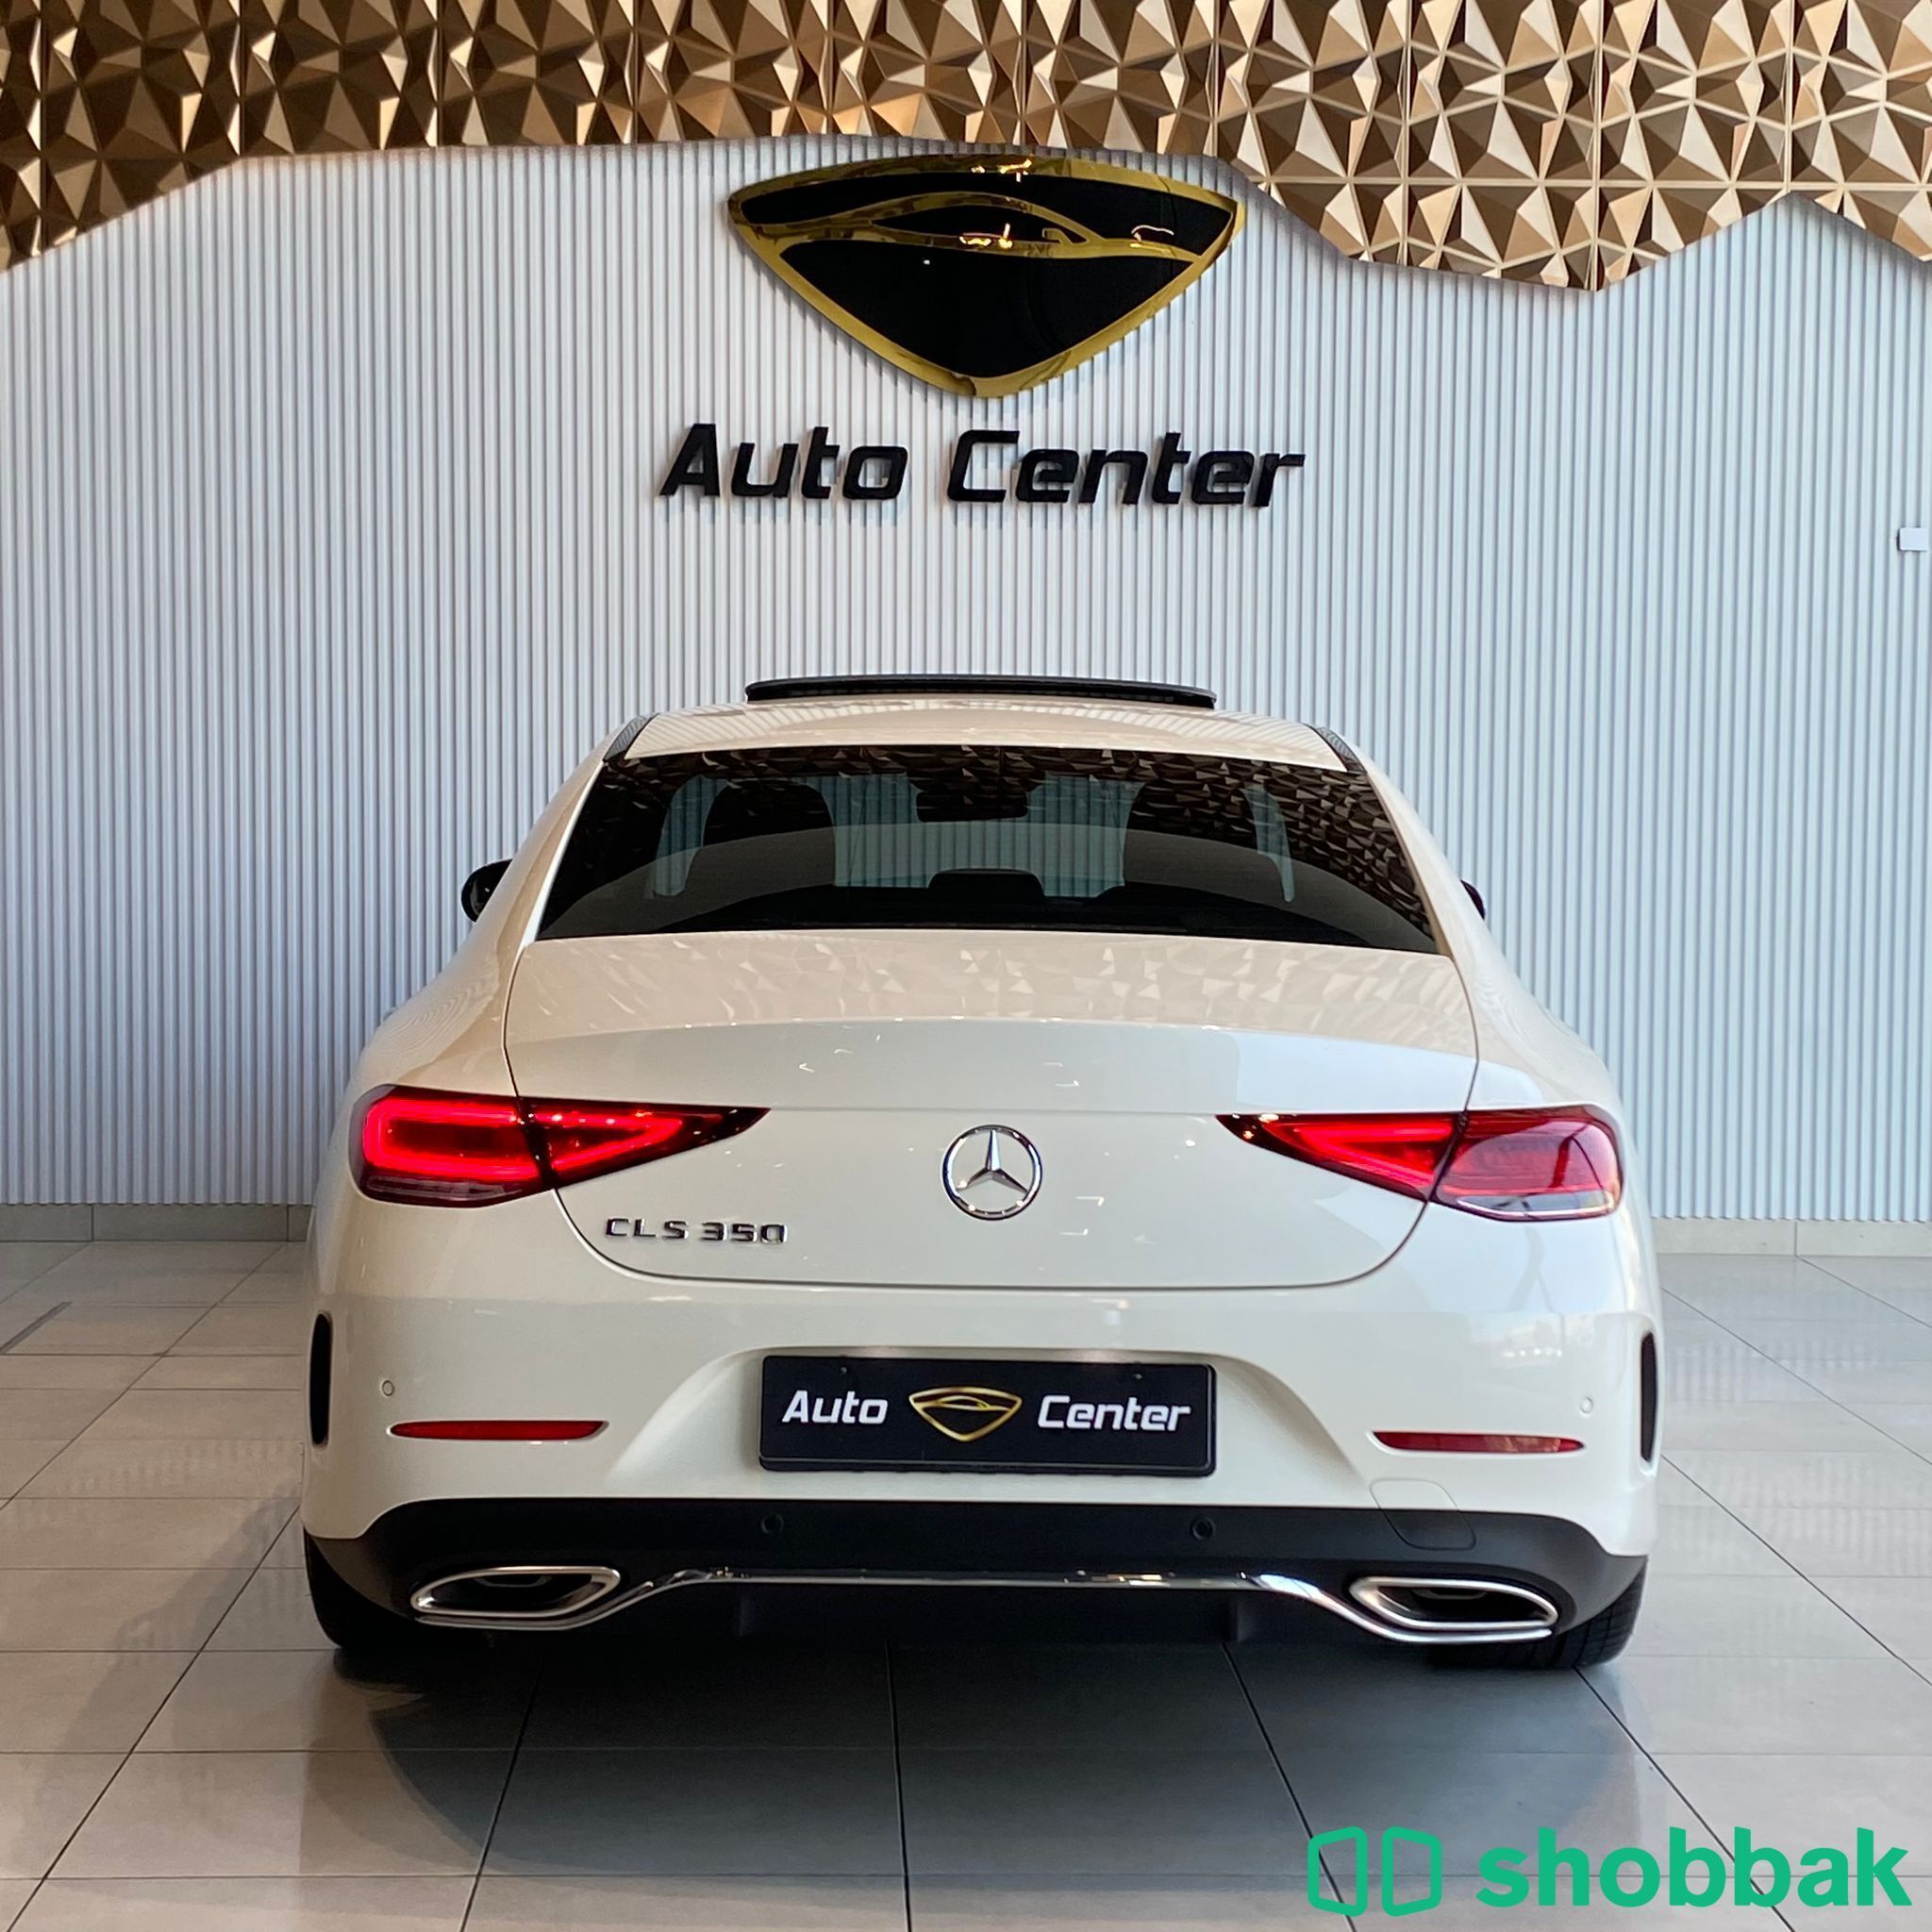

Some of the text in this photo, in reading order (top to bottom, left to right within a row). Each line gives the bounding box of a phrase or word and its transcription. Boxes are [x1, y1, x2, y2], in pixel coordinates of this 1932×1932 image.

[659, 422, 1306, 508] Auto Center
[606, 1218, 788, 1244] CLS 350
[782, 1390, 1191, 1432] Auto Center
